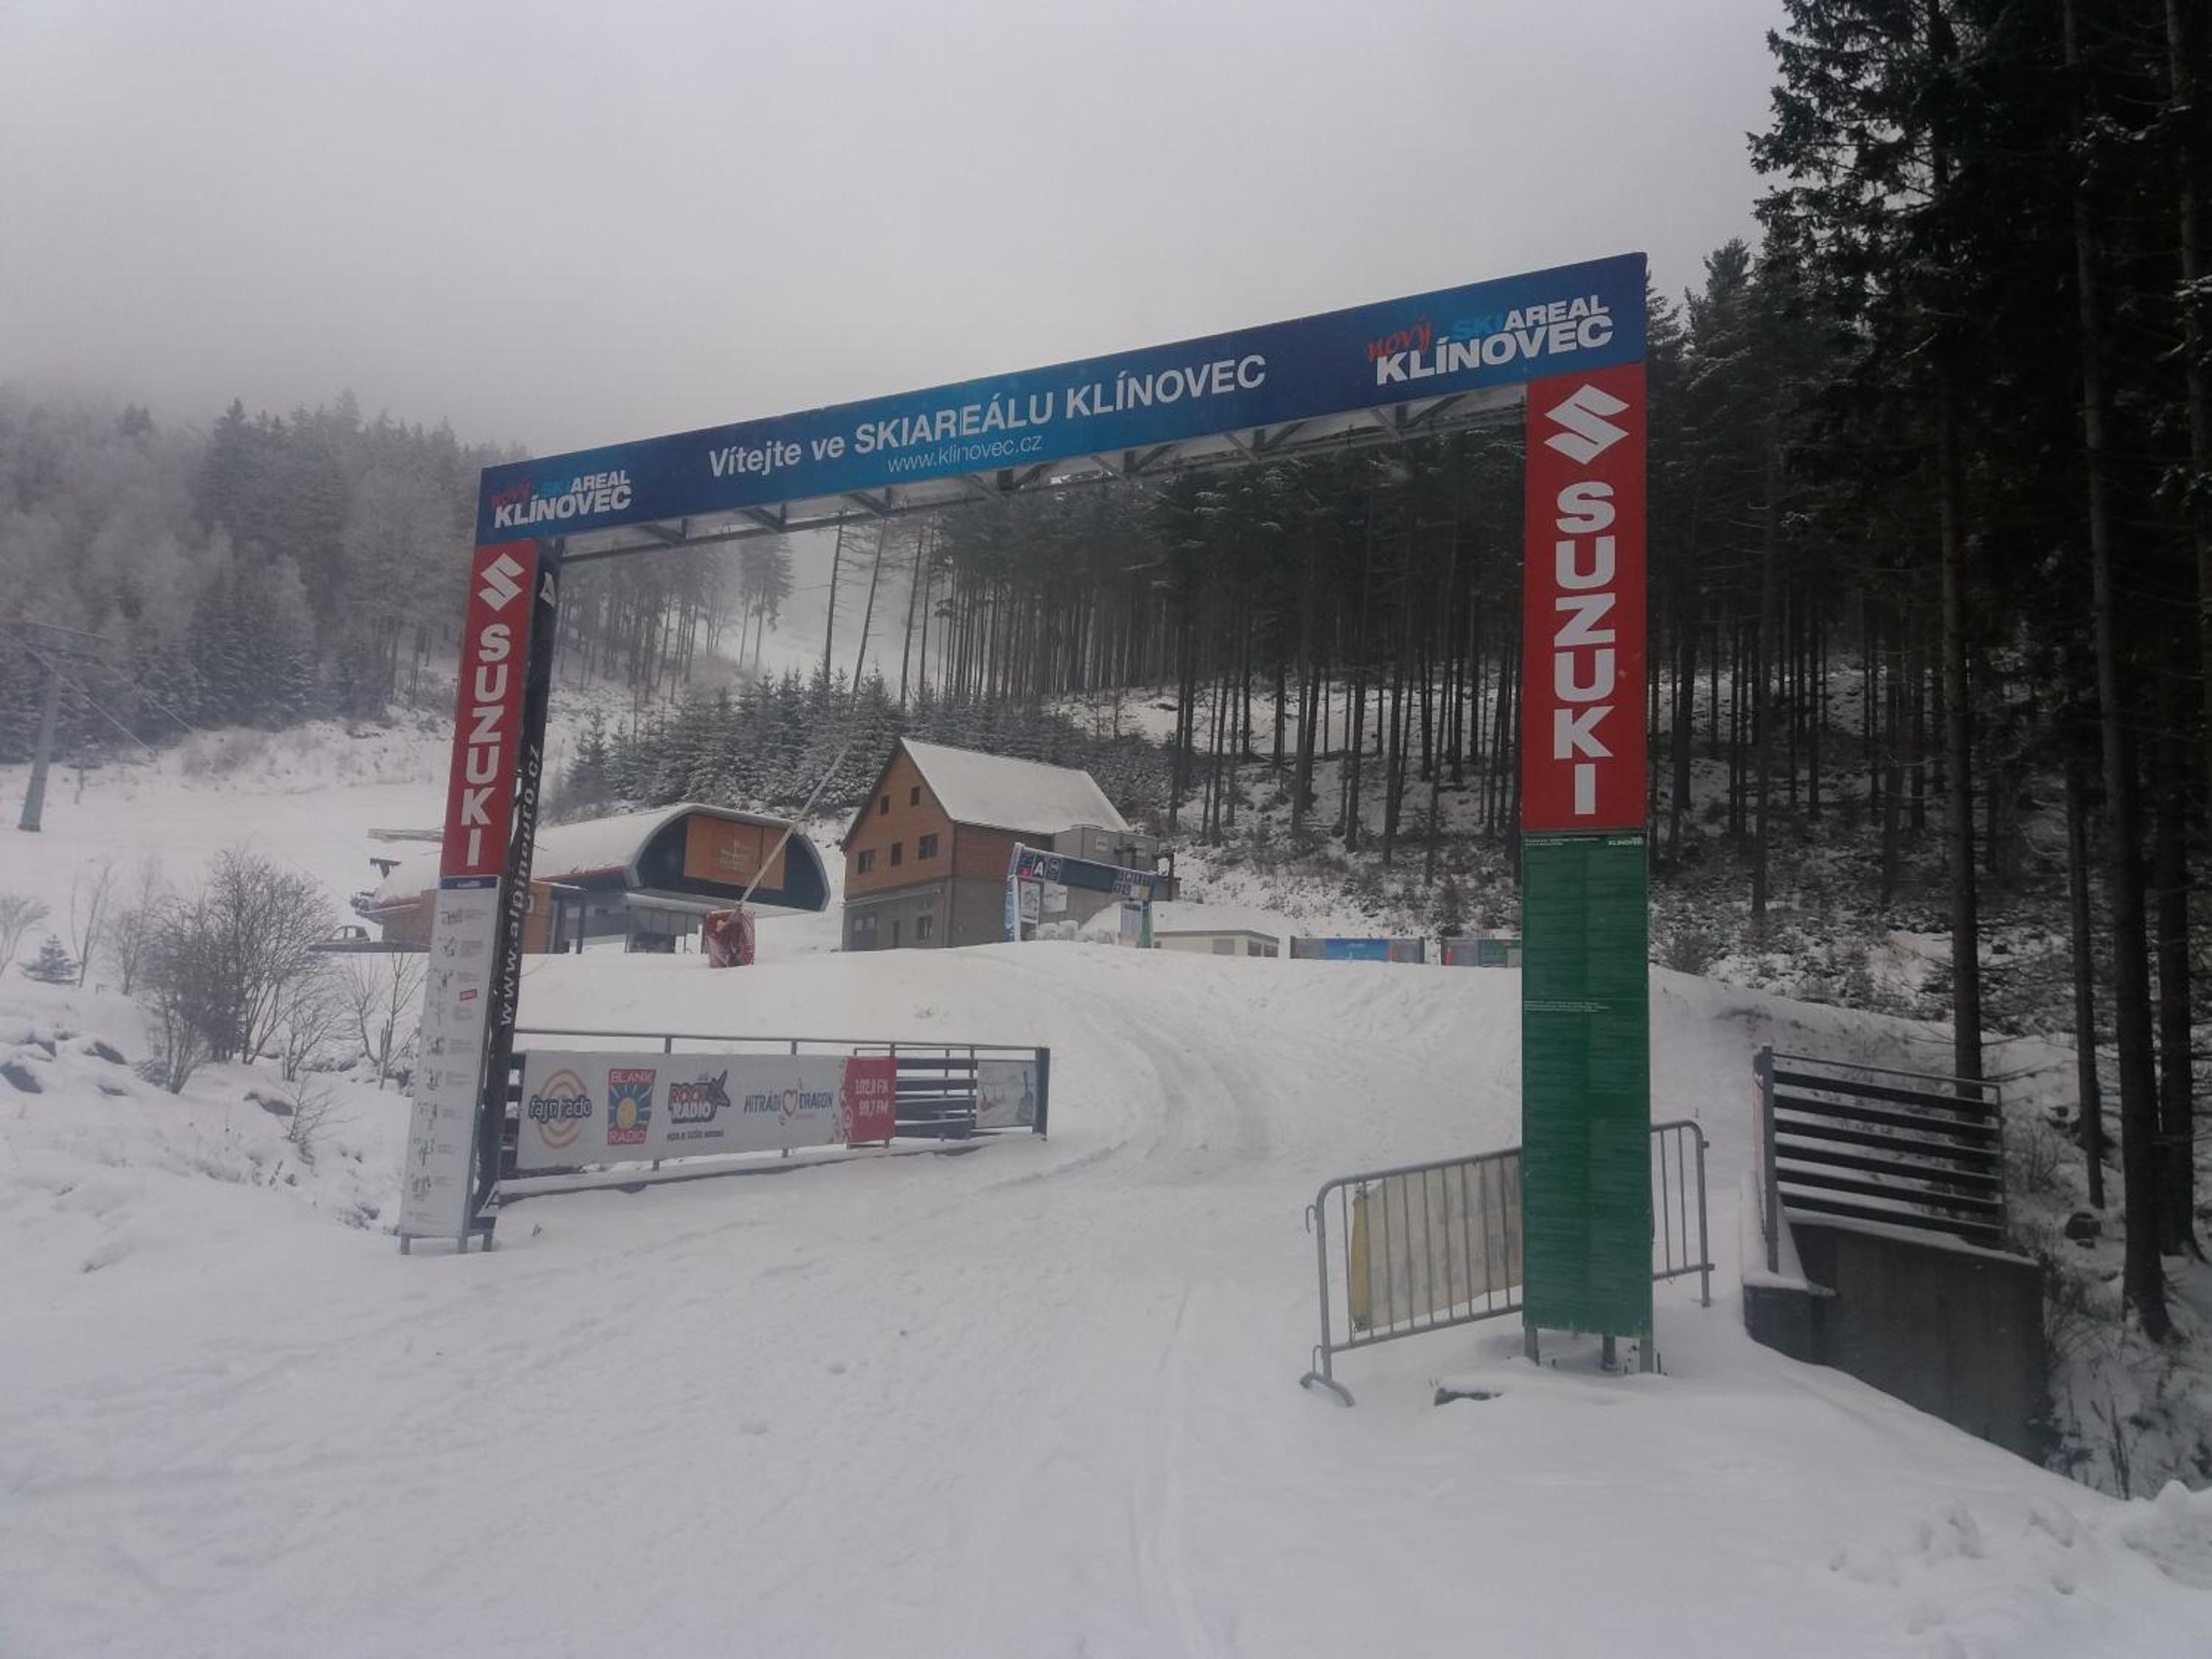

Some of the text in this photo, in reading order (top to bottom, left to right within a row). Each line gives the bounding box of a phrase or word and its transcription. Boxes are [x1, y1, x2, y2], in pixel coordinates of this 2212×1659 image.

[1376, 315, 1615, 386] KLÍNOVEC
[709, 354, 1267, 479] Vítejte ve SKIAREÁLU KLÍNOVEC
[887, 435, 1043, 473] www.klinovec.cz
[495, 485, 632, 529] KLÍNOVEC
[1553, 481, 1615, 815] SUZUKI
[461, 623, 512, 867] SUZUKI
[799, 1091, 834, 1110] DRAGON
